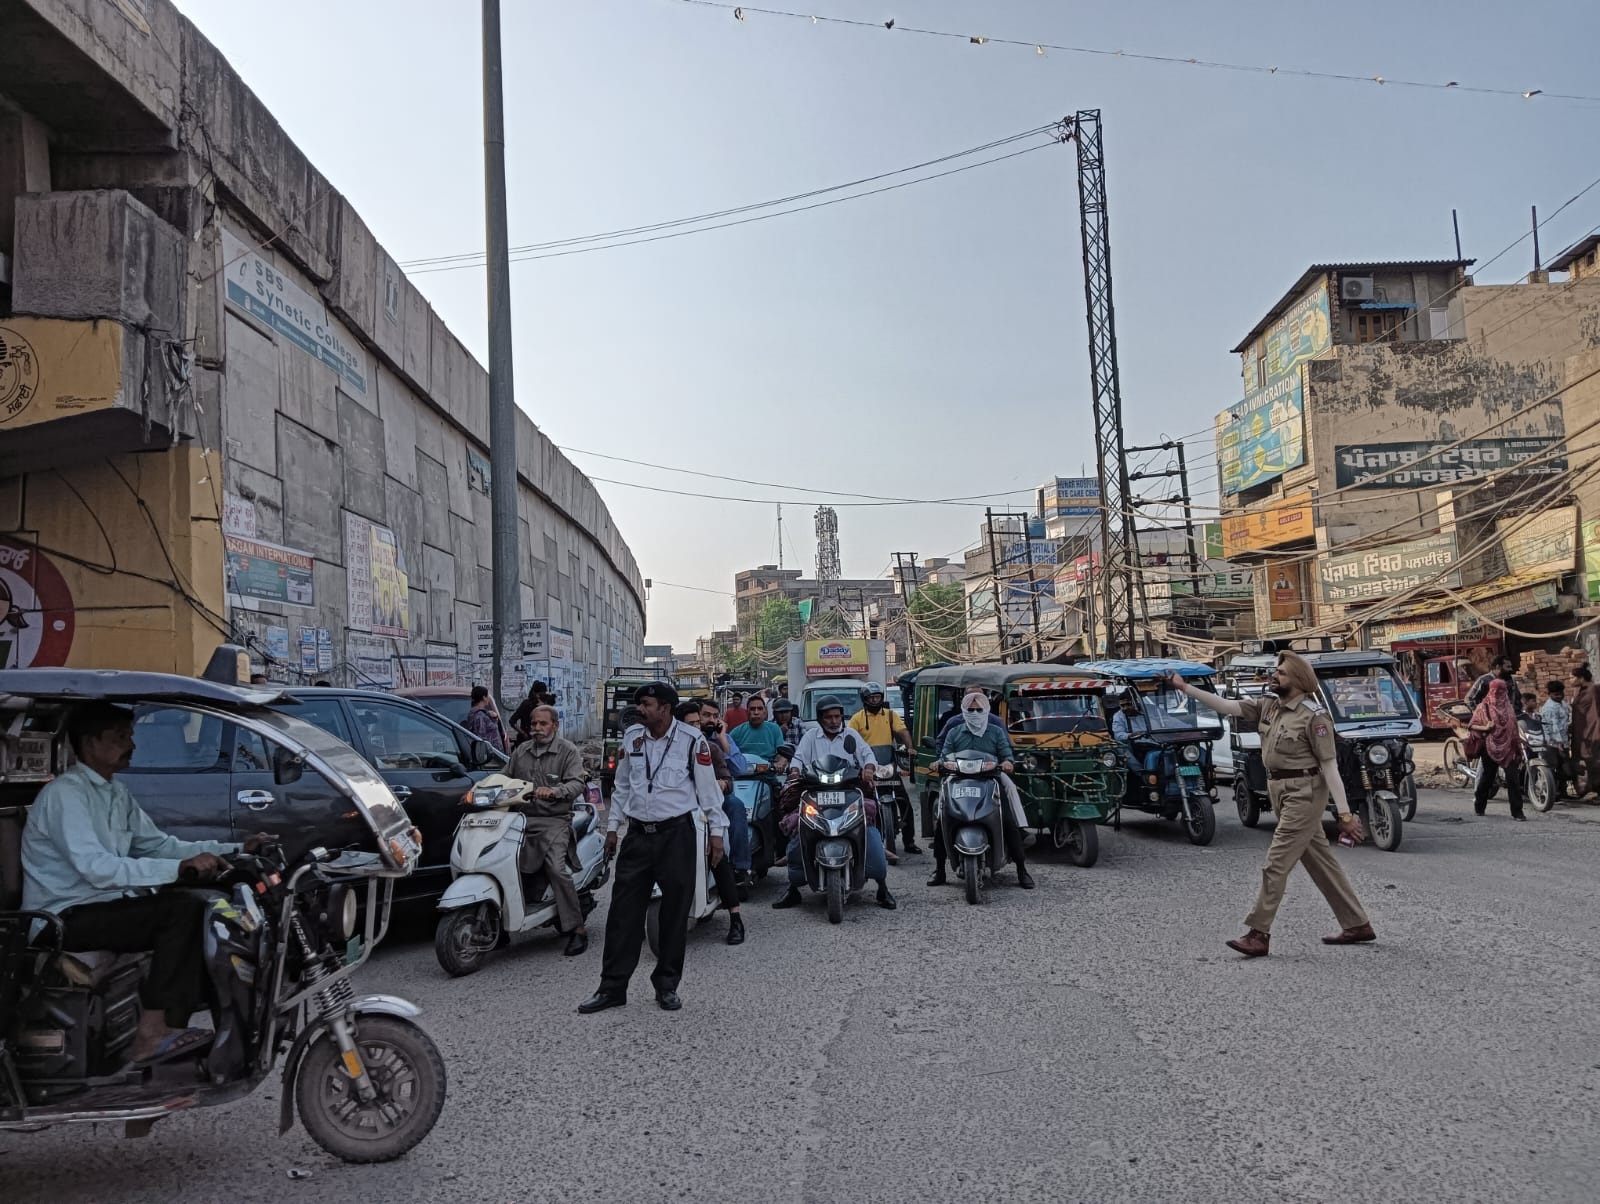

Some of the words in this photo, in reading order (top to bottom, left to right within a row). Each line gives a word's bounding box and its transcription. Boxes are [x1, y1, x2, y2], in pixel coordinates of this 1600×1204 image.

[254, 260, 284, 292] SBS
[256, 279, 311, 332] Synetic
[315, 324, 358, 368] College
[1249, 374, 1296, 412] IMMIGRATION
[256, 545, 313, 569] INTERNATIONAL
[1322, 562, 1359, 582] ਪੰਜਾਬ
